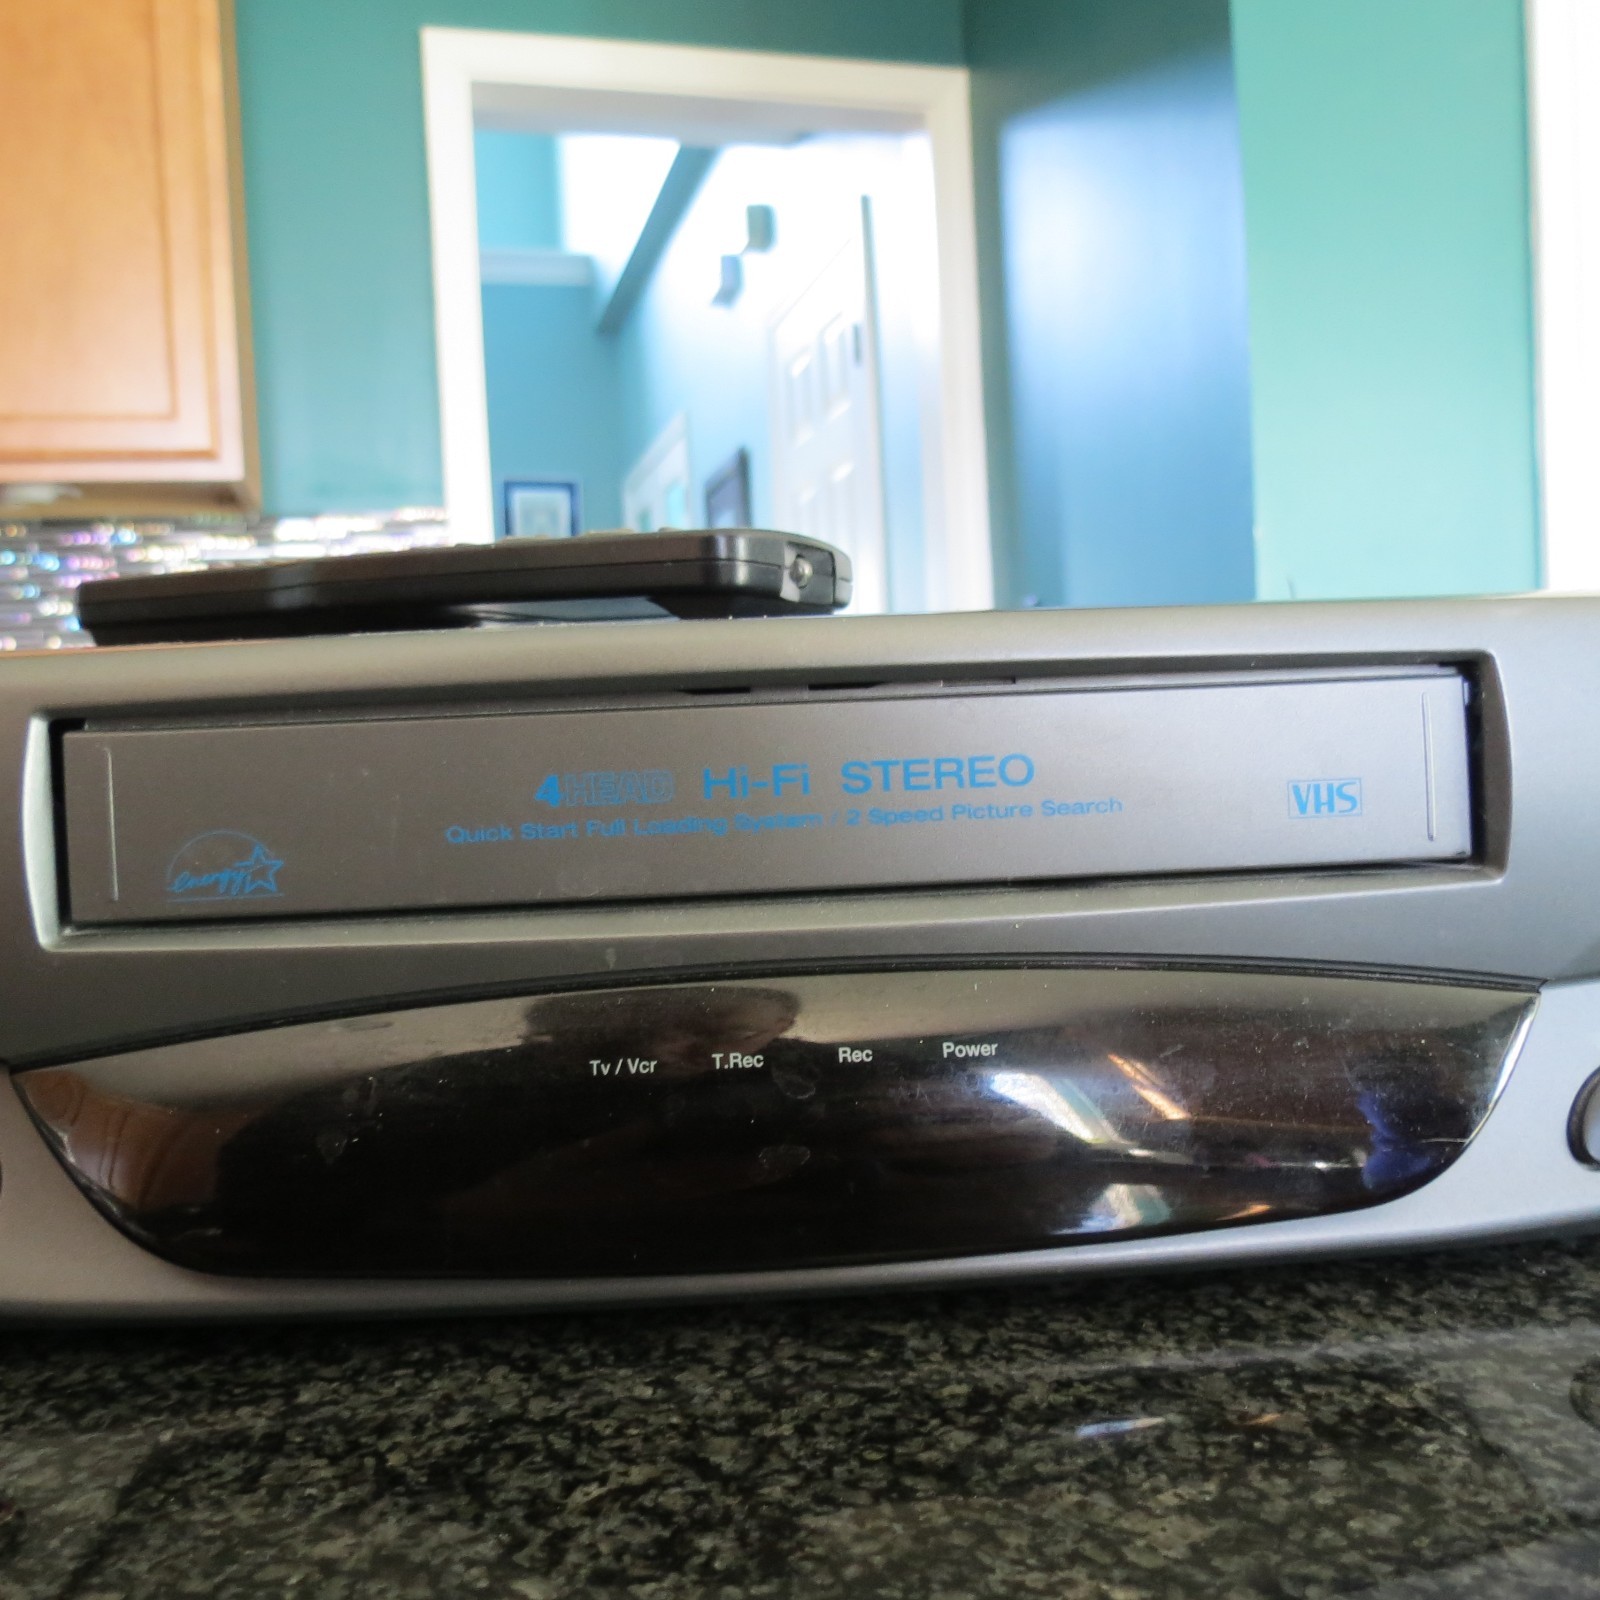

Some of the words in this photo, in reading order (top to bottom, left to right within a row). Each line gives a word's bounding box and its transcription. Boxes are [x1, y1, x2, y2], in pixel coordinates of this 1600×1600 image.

[703, 763, 810, 800] Hi-Fi
[841, 753, 1036, 796] STEREO
[1292, 781, 1358, 815] VHS
[445, 824, 514, 844] Quick
[520, 821, 579, 841] Start
[586, 818, 627, 838] Full
[633, 816, 729, 837] Loading
[734, 811, 823, 834] System
[846, 808, 862, 826] 2
[868, 805, 944, 827] Speed
[952, 801, 1034, 821] Picture
[1041, 797, 1124, 817] Search
[838, 1047, 874, 1064] Rec
[942, 1041, 999, 1059] Power
[589, 1060, 612, 1076] Tv
[627, 1058, 658, 1075] Vcr
[712, 1053, 765, 1070] T.Rec
